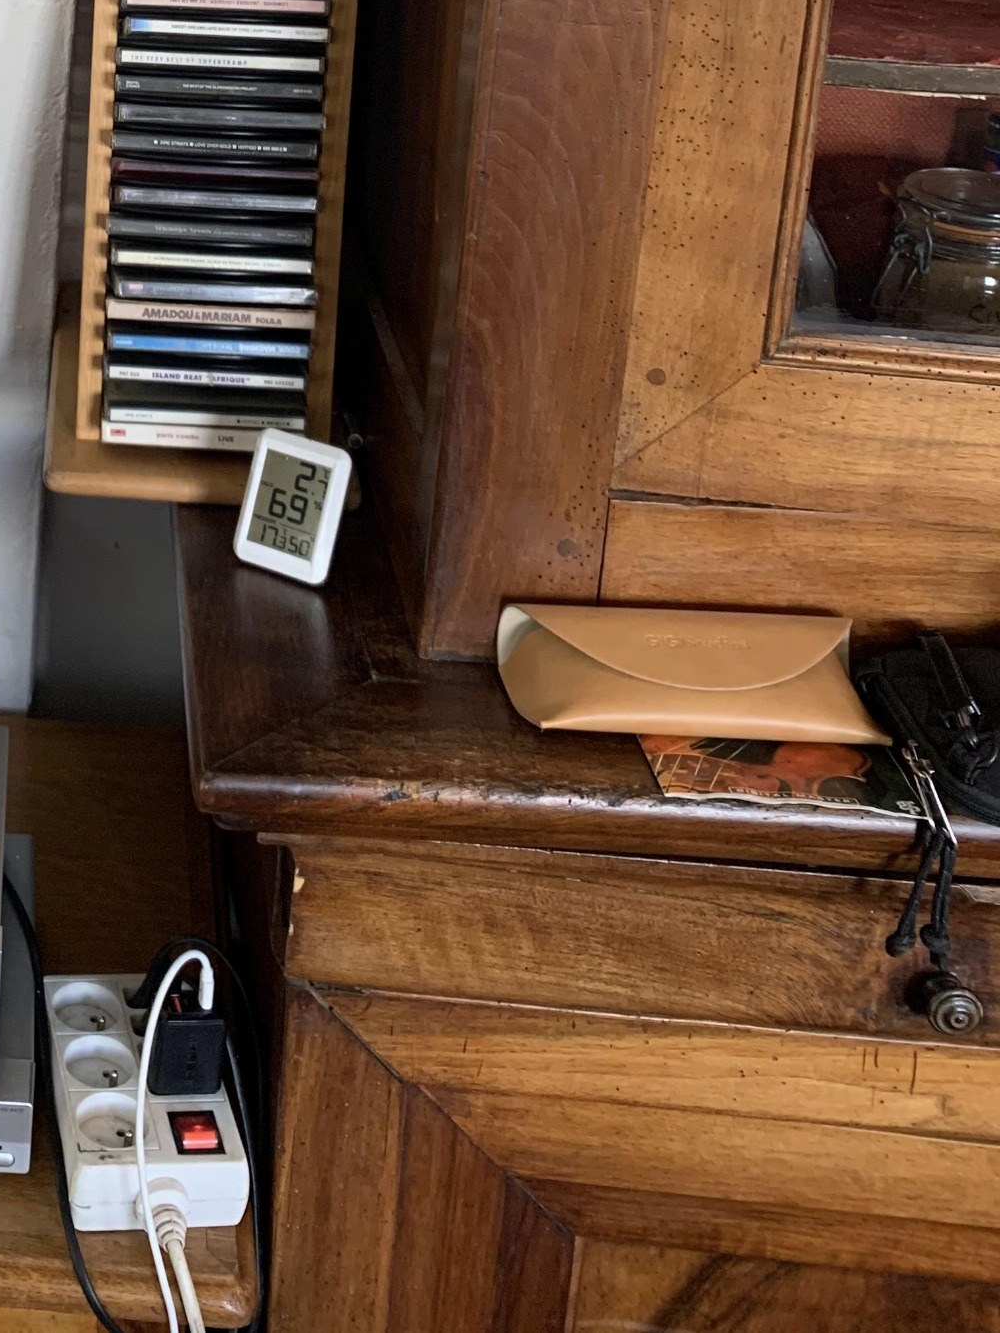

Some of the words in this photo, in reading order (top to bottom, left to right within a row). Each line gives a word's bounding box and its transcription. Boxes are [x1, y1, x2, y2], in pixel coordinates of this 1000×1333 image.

[198, 58, 248, 66] SUPERTRAMP
[142, 307, 194, 321] AMADOU
[194, 313, 201, 321] &
[201, 311, 252, 323] MARIAM
[151, 371, 181, 380] ISLAND
[183, 373, 203, 382] BEAT
[156, 432, 174, 441] paris
[217, 435, 235, 443] LIVE
[268, 488, 308, 525] 69
[734, 787, 788, 798] DIGITAL
[796, 793, 846, 804] MASTER
